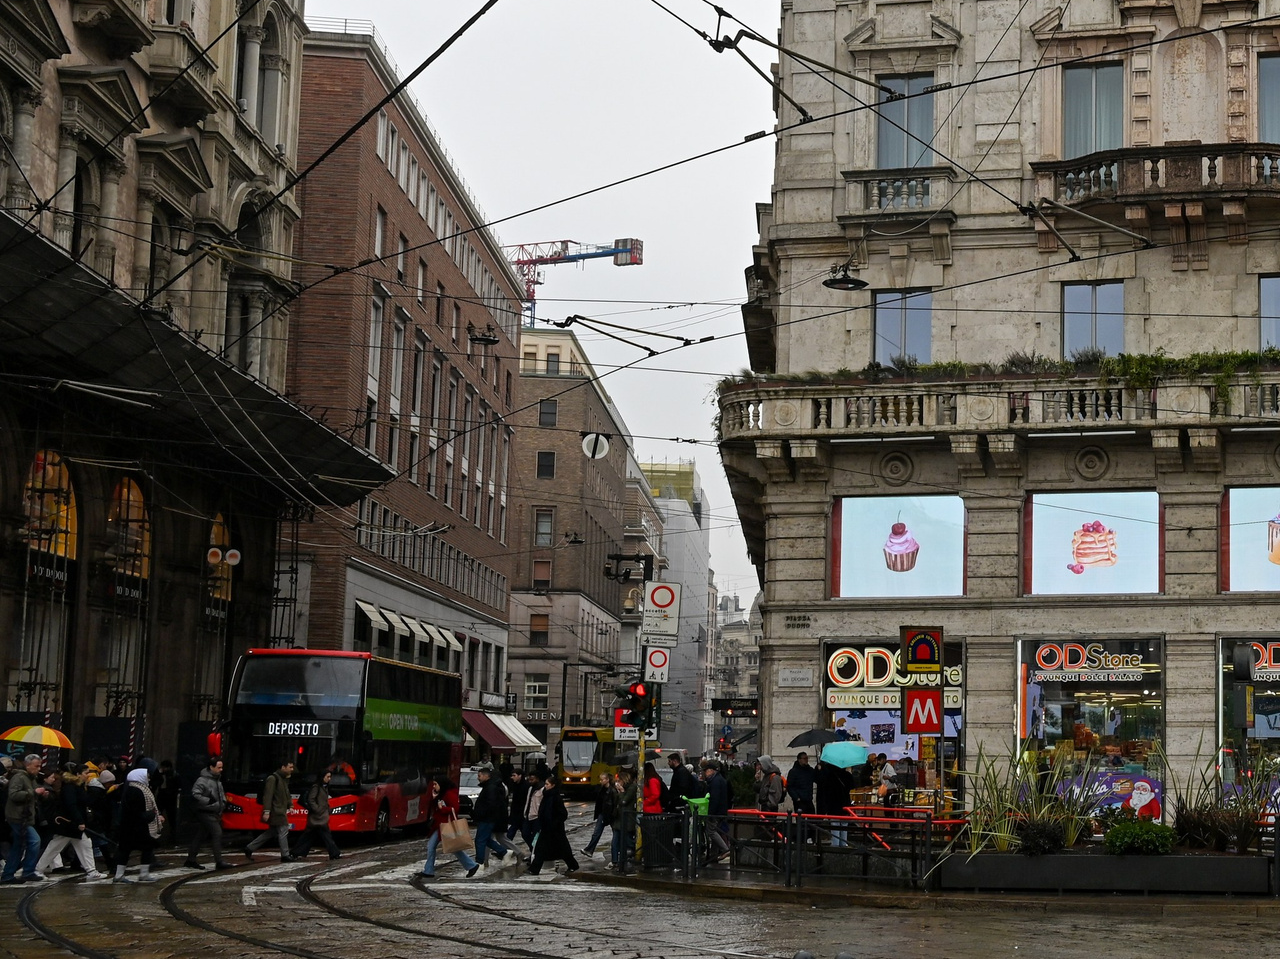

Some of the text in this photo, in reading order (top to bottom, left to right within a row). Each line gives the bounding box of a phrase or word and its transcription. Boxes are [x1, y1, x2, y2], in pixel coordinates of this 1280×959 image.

[1036, 643, 1142, 671] ODStore
[1036, 673, 1143, 683] OVUNQUE DOLCE SALATO
[829, 695, 880, 706] OVUNQUE
[908, 698, 938, 725] M
[268, 722, 319, 736] DEPOSITO
[389, 713, 404, 729] OPEN
[405, 714, 418, 730] TOUR
